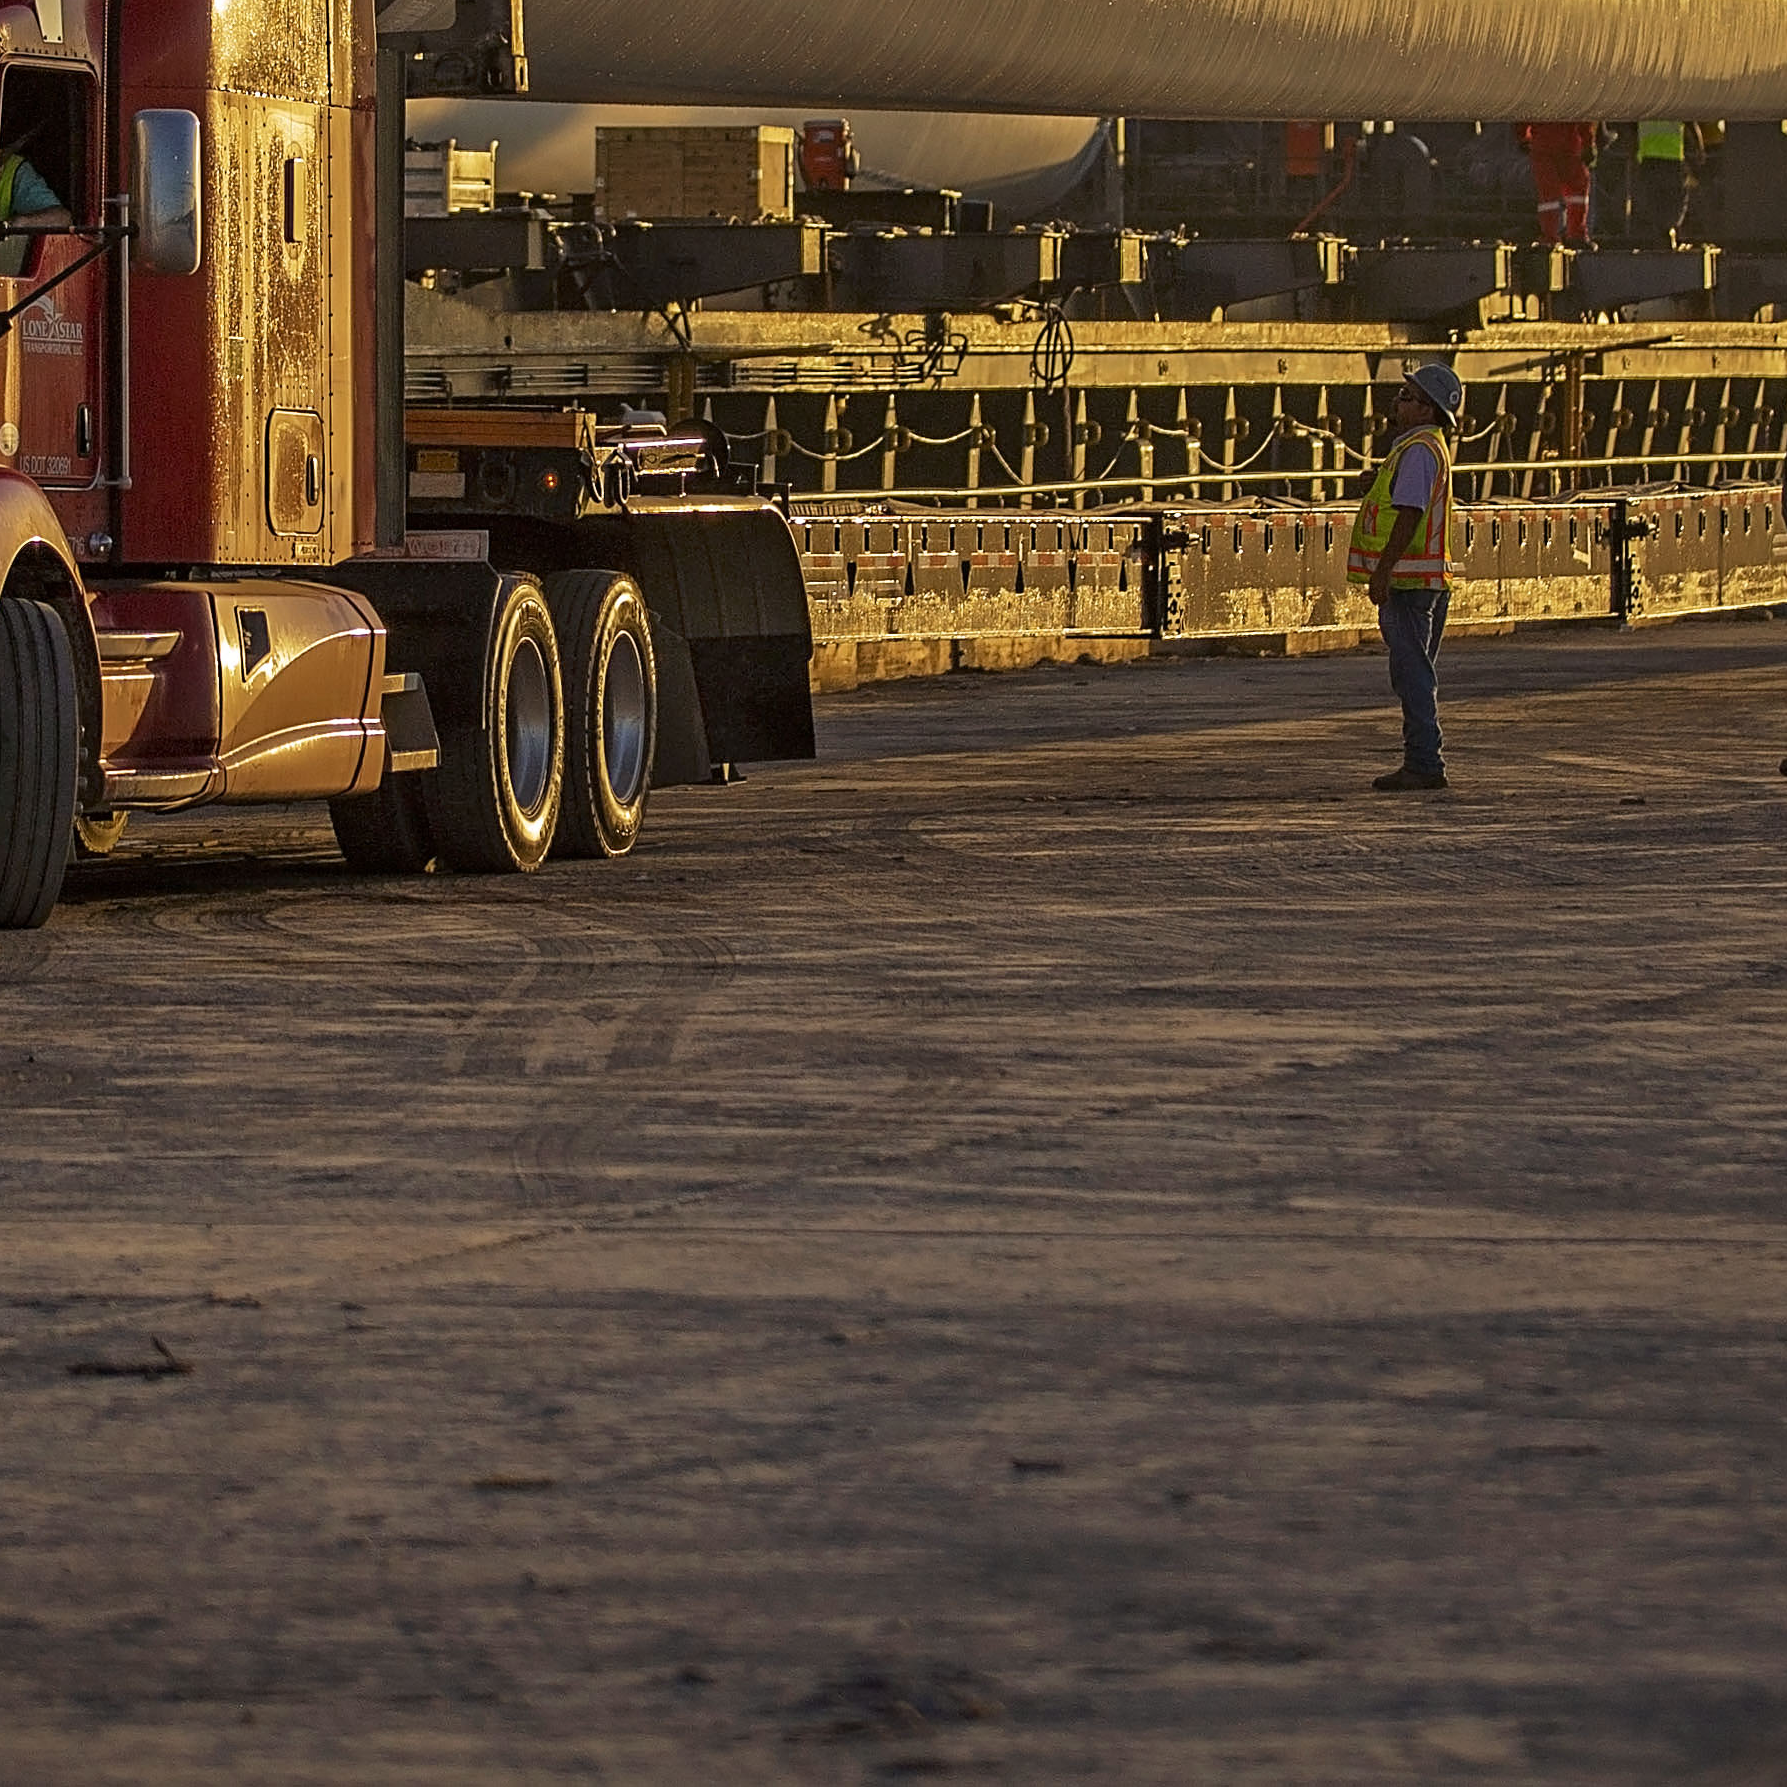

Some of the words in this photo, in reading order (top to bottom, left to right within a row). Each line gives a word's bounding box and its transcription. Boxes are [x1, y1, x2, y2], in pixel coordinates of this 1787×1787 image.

[22, 320, 48, 337] LONE
[59, 322, 83, 339] STAR
[19, 455, 30, 473] US
[31, 455, 47, 474] DOT
